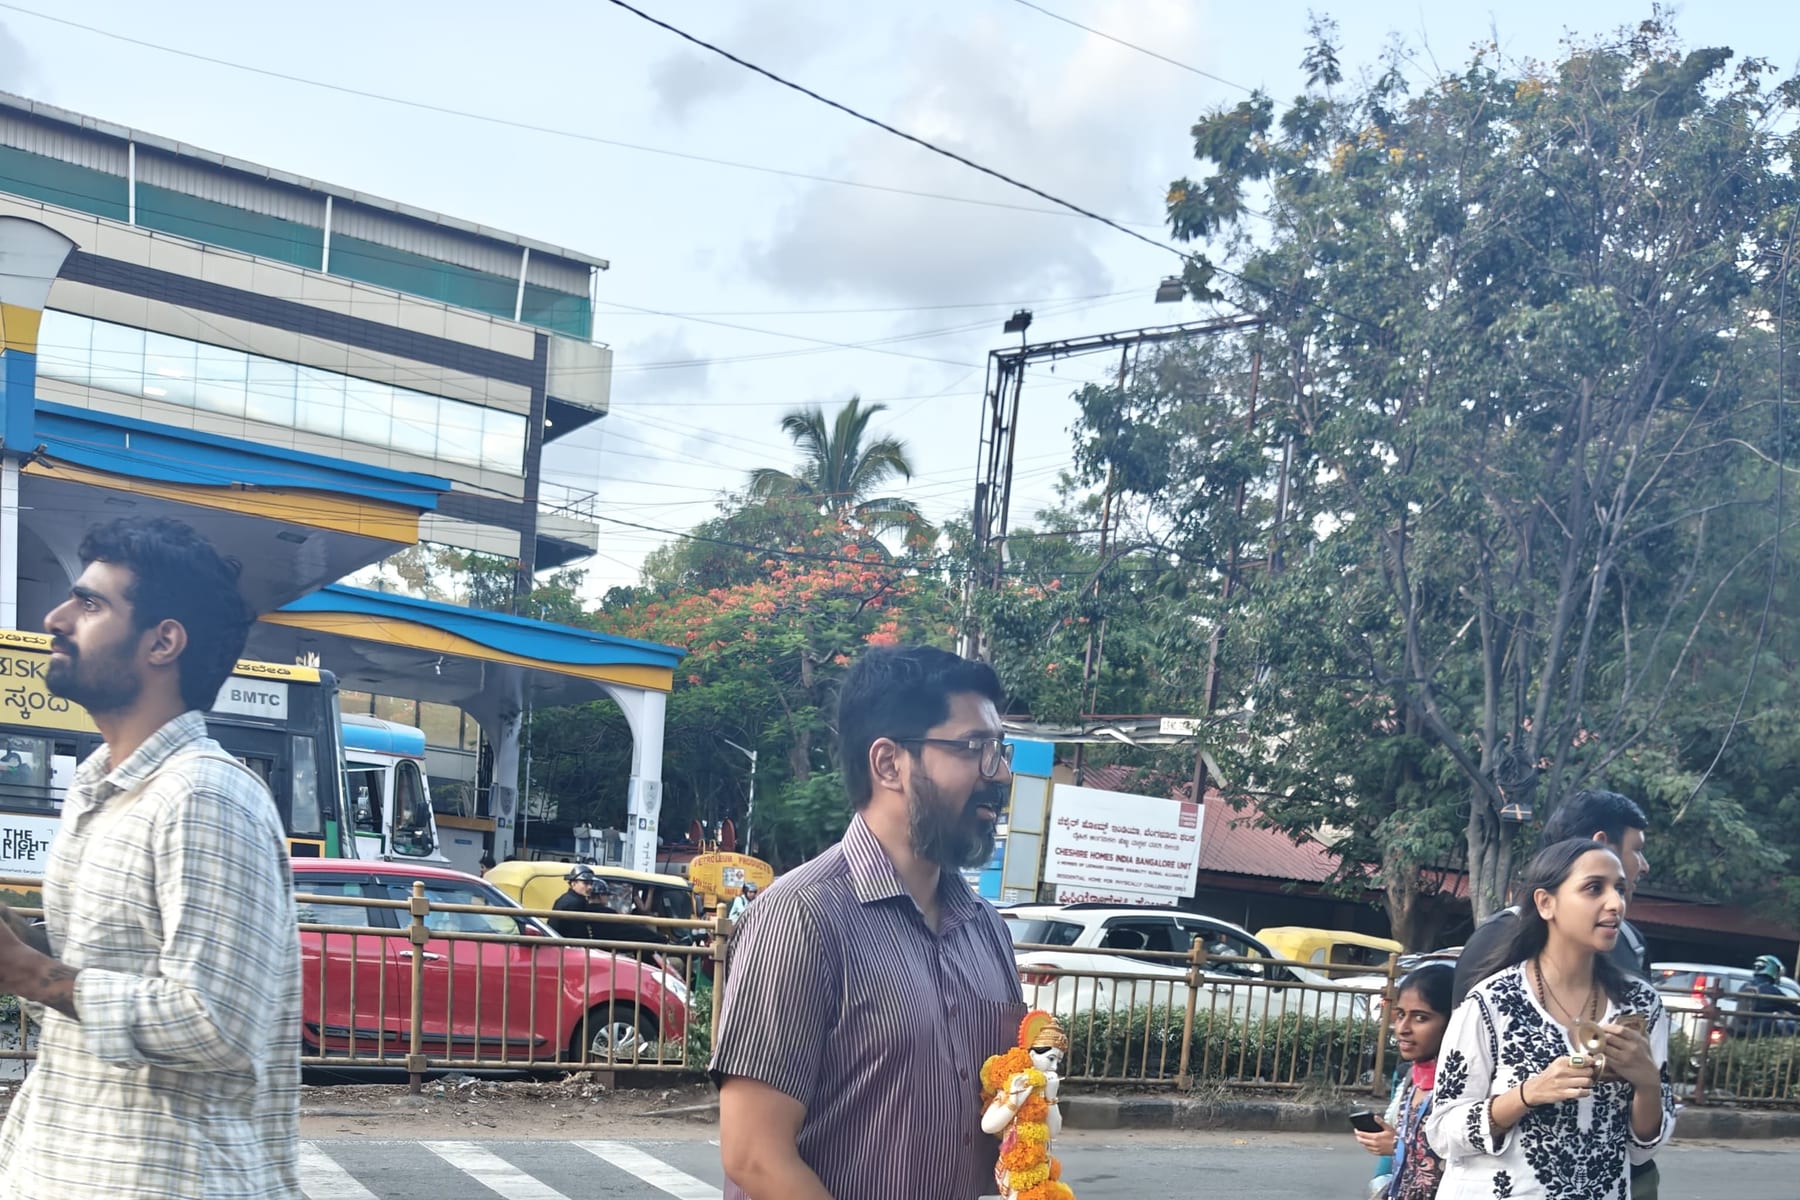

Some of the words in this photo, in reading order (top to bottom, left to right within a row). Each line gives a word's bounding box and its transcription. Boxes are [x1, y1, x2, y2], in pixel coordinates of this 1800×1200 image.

[15, 659, 46, 680] SK
[231, 689, 280, 706] BMTC
[3, 828, 32, 840] THE
[3, 839, 49, 851] RIGHT
[3, 850, 35, 860] LIFE
[1055, 847, 1089, 859] CHESHIRE
[1090, 851, 1113, 861] HOMES
[1115, 854, 1133, 864] INDIA
[1135, 856, 1176, 868] BANGALORE
[1177, 862, 1192, 870] UNIT
[694, 855, 733, 866] PETROLEUM
[739, 856, 770, 874] PRODUCTS
